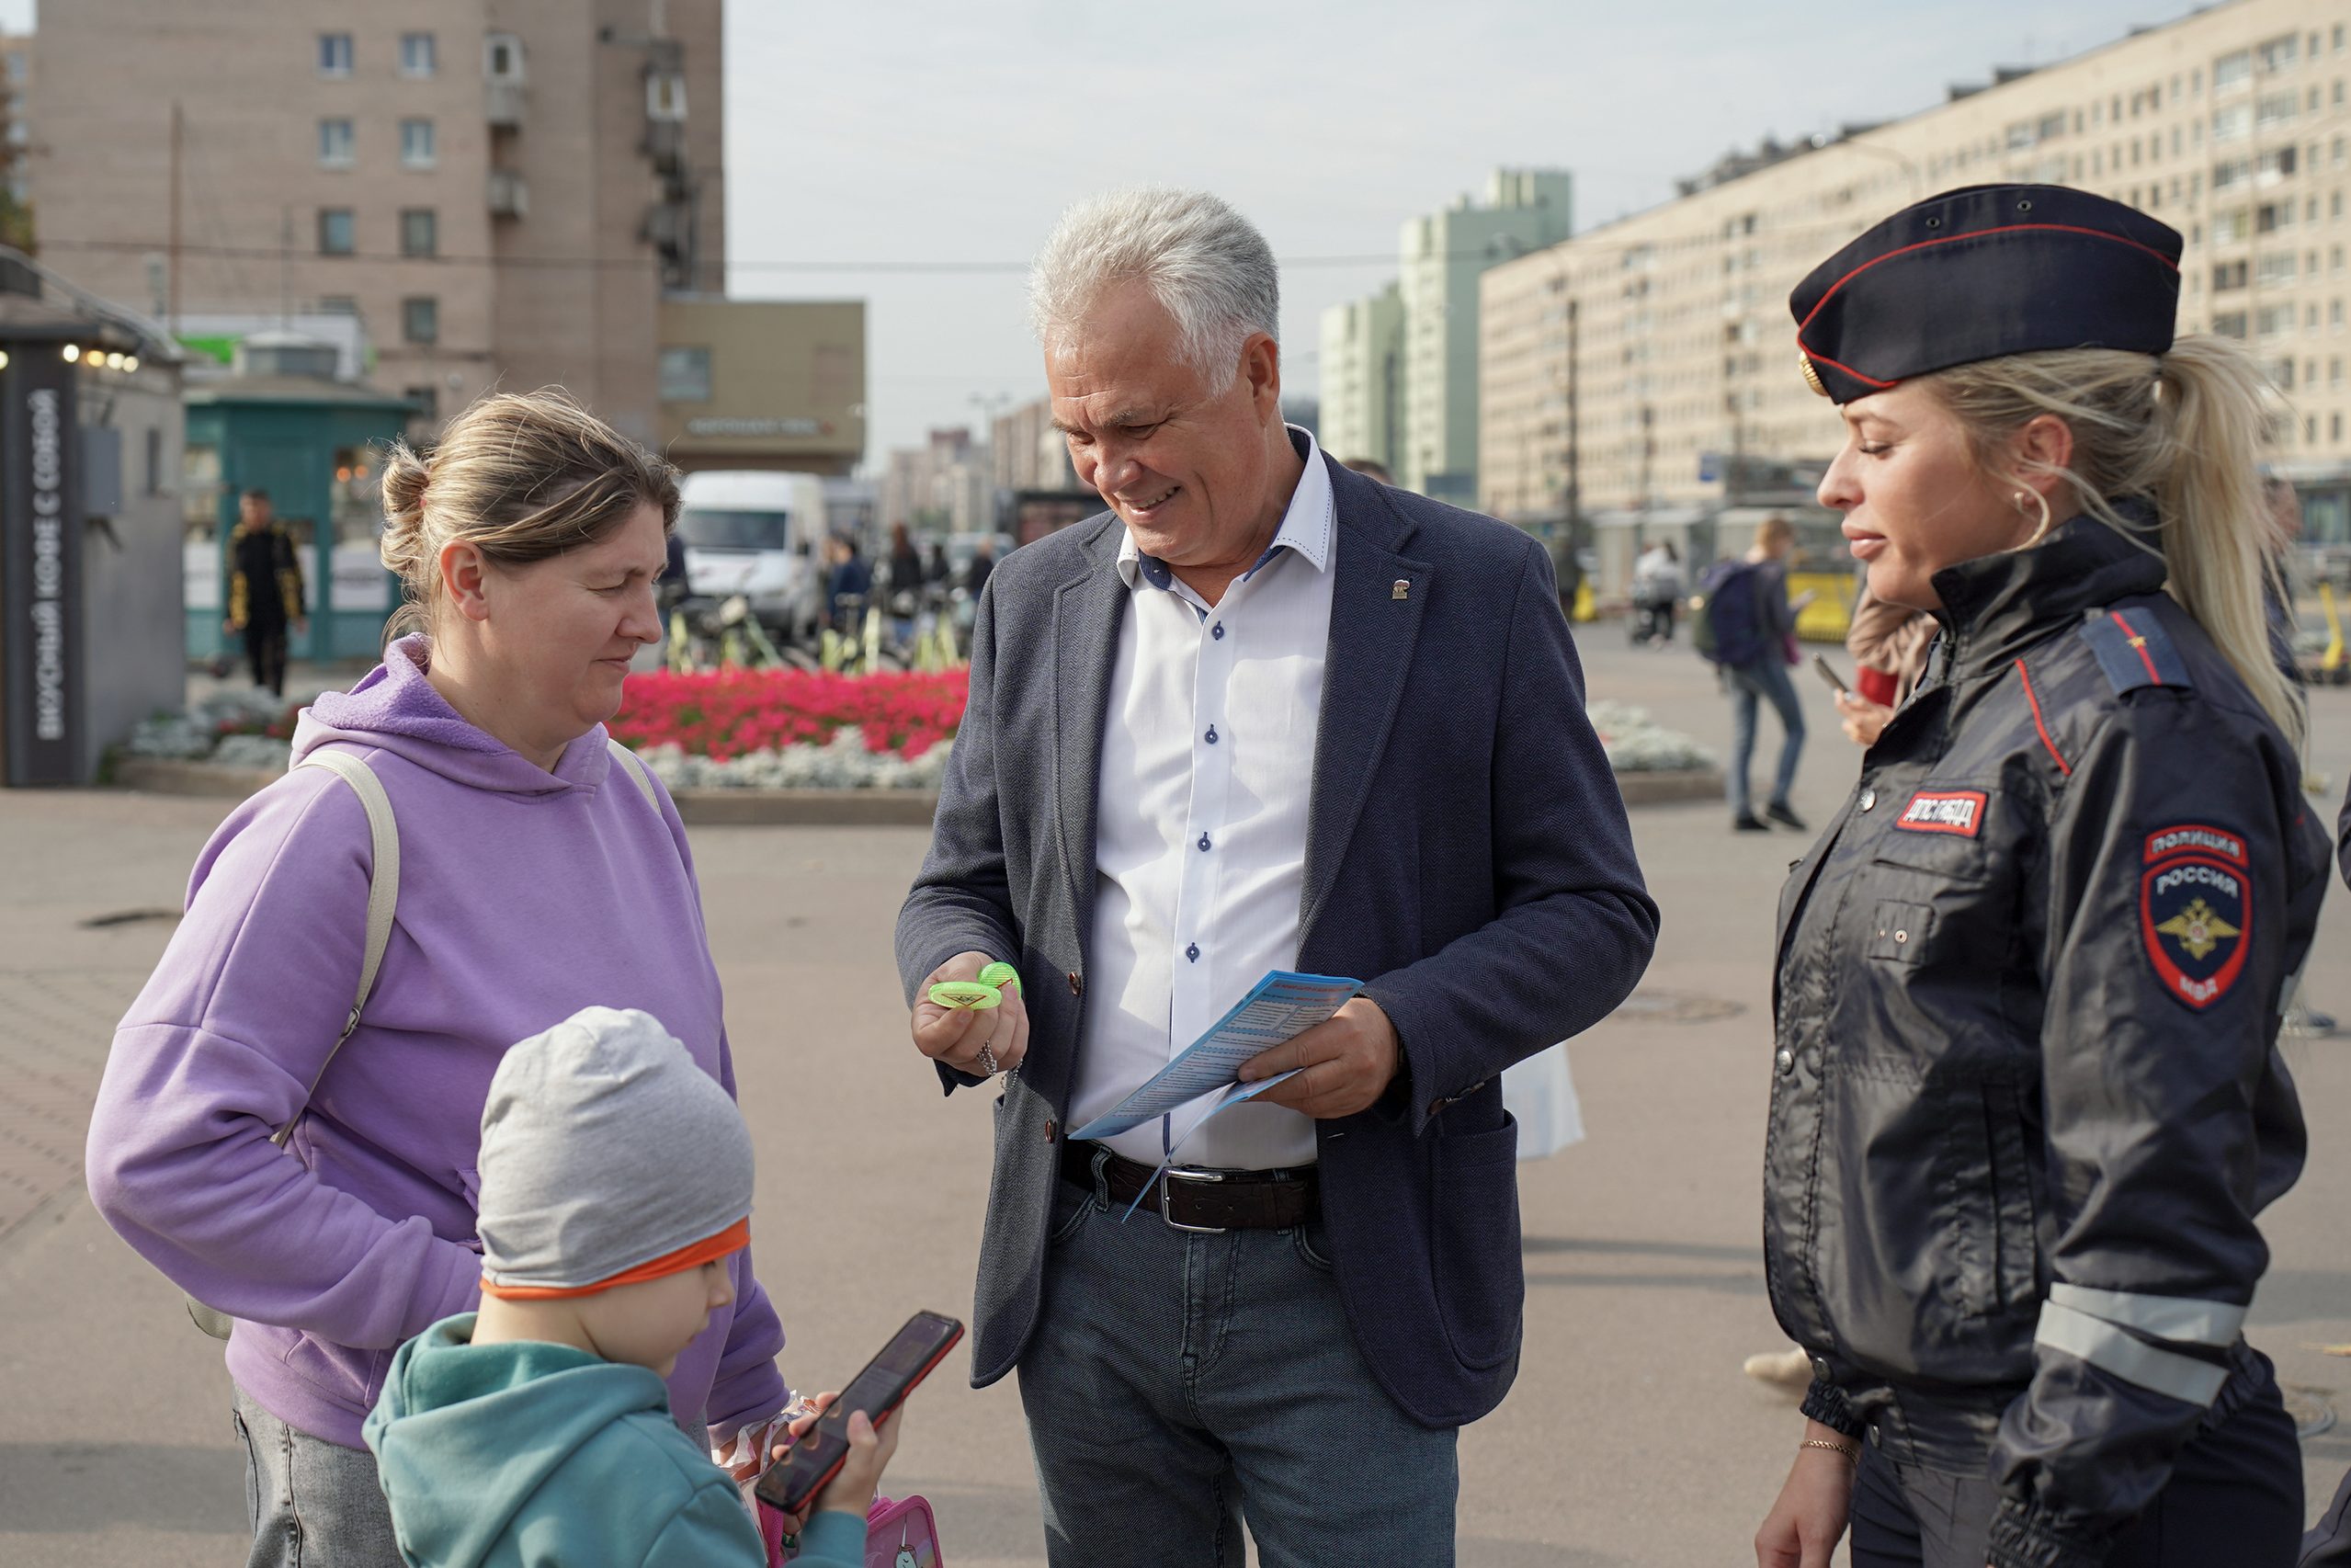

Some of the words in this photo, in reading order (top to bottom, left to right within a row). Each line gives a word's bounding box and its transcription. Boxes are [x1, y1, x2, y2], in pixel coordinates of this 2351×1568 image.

[28, 388, 61, 491] СОБОЙ
[34, 491, 61, 515] С
[34, 517, 62, 598] КОФЕ
[30, 600, 64, 740] ВКУСНЫЙ
[2152, 830, 2240, 858] ПОЛИЦИЯ
[2155, 866, 2239, 898] РОССИЯ
[2179, 975, 2218, 1001] МВД
